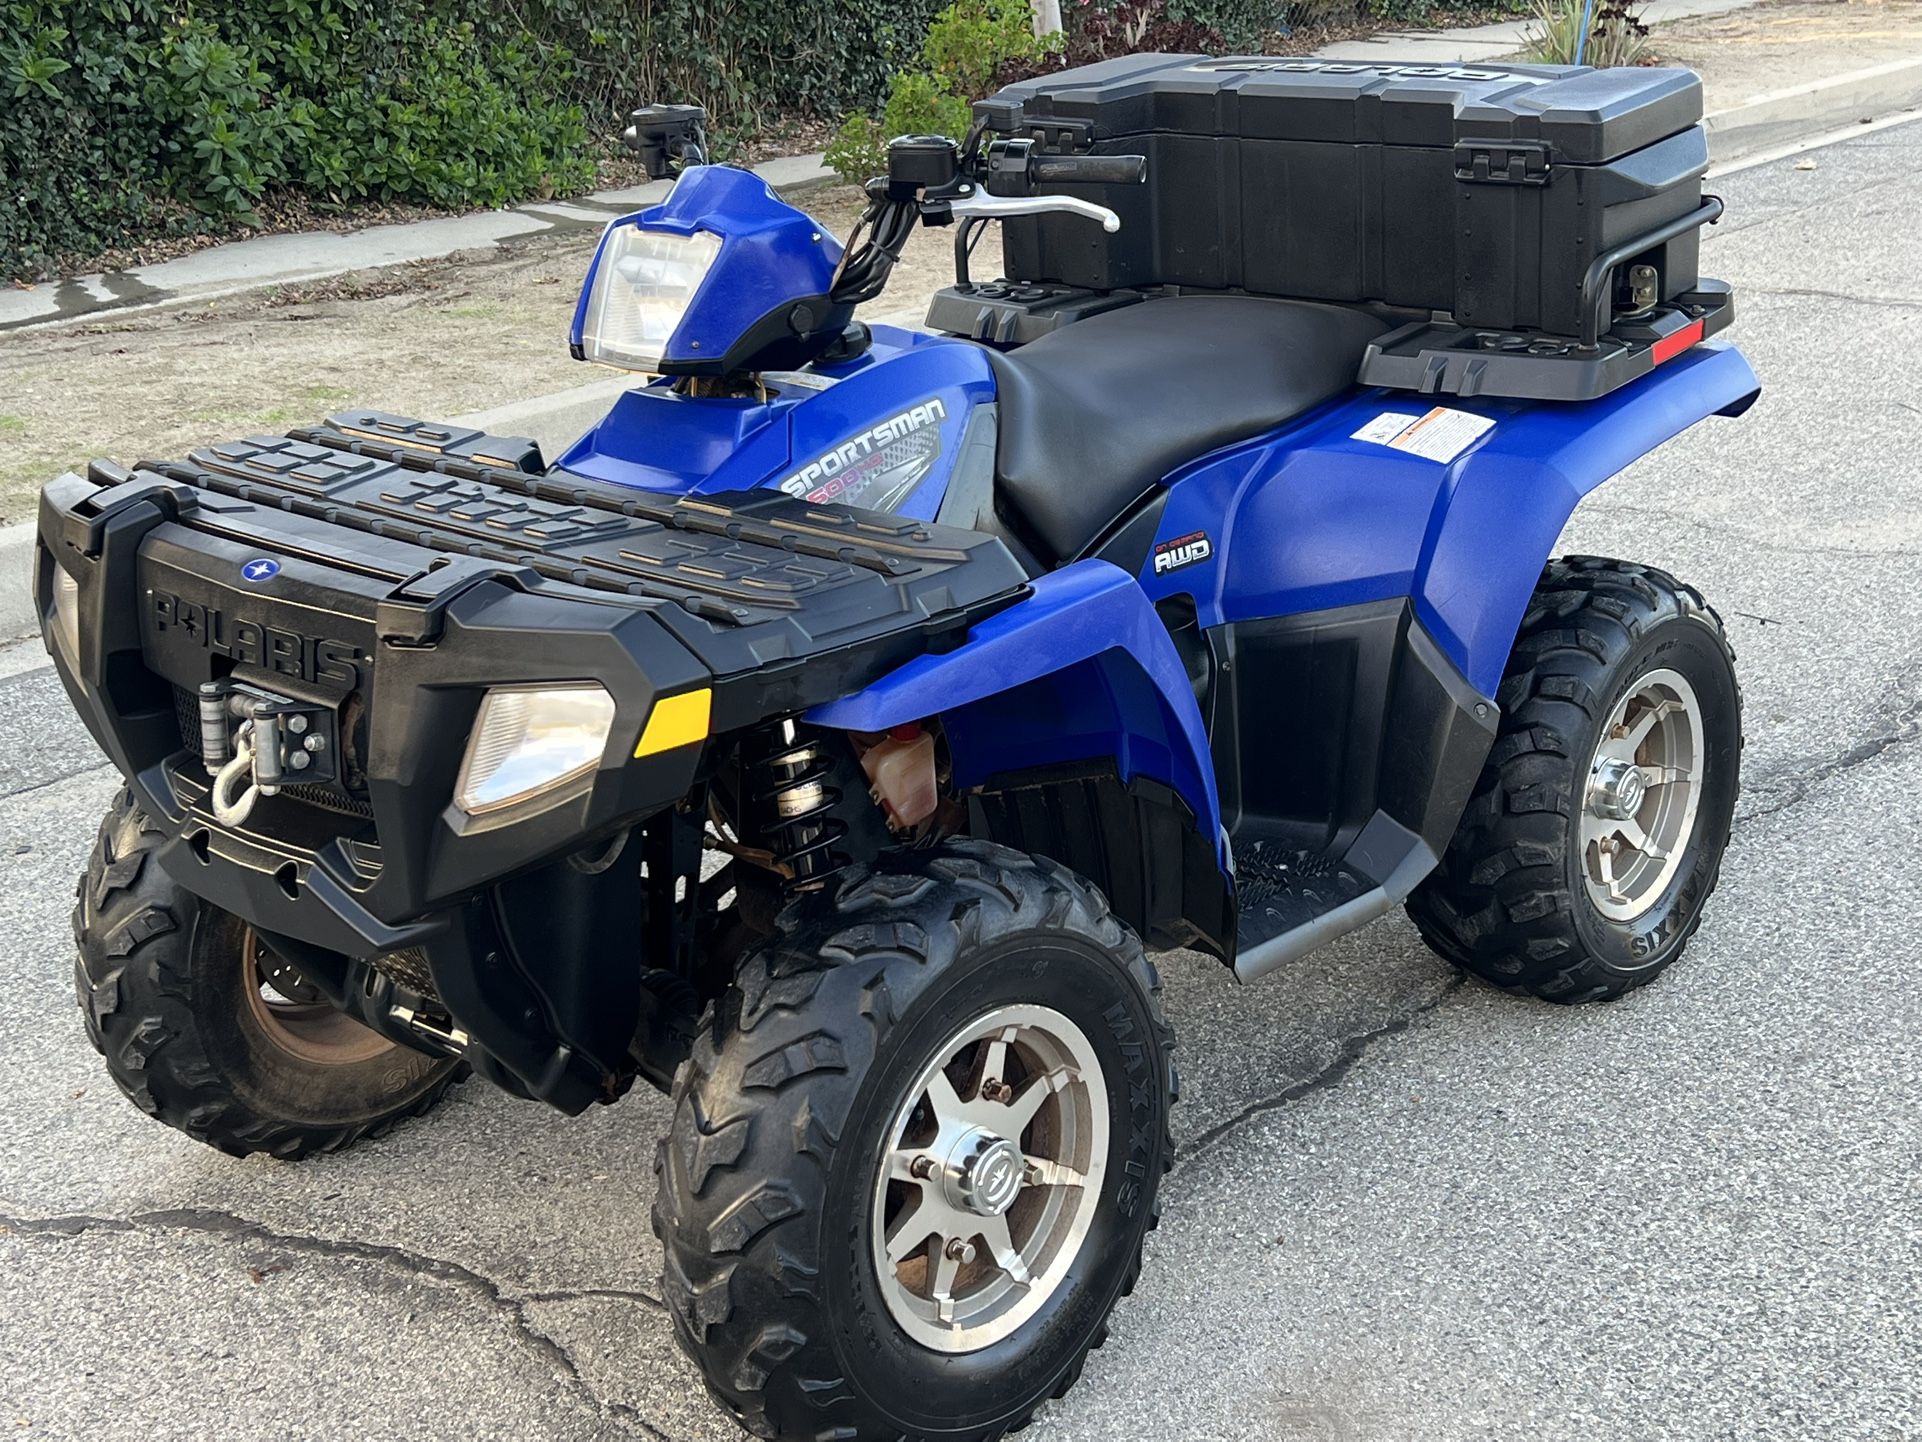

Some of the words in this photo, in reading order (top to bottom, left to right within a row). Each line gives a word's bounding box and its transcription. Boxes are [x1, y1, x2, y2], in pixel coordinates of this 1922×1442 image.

[780, 399, 945, 498] SPORTSMAN
[806, 466, 861, 504] 500
[1154, 539, 1209, 572] AWD
[154, 590, 360, 690] POLARIS
[1102, 1001, 1150, 1217] MAXXIS
